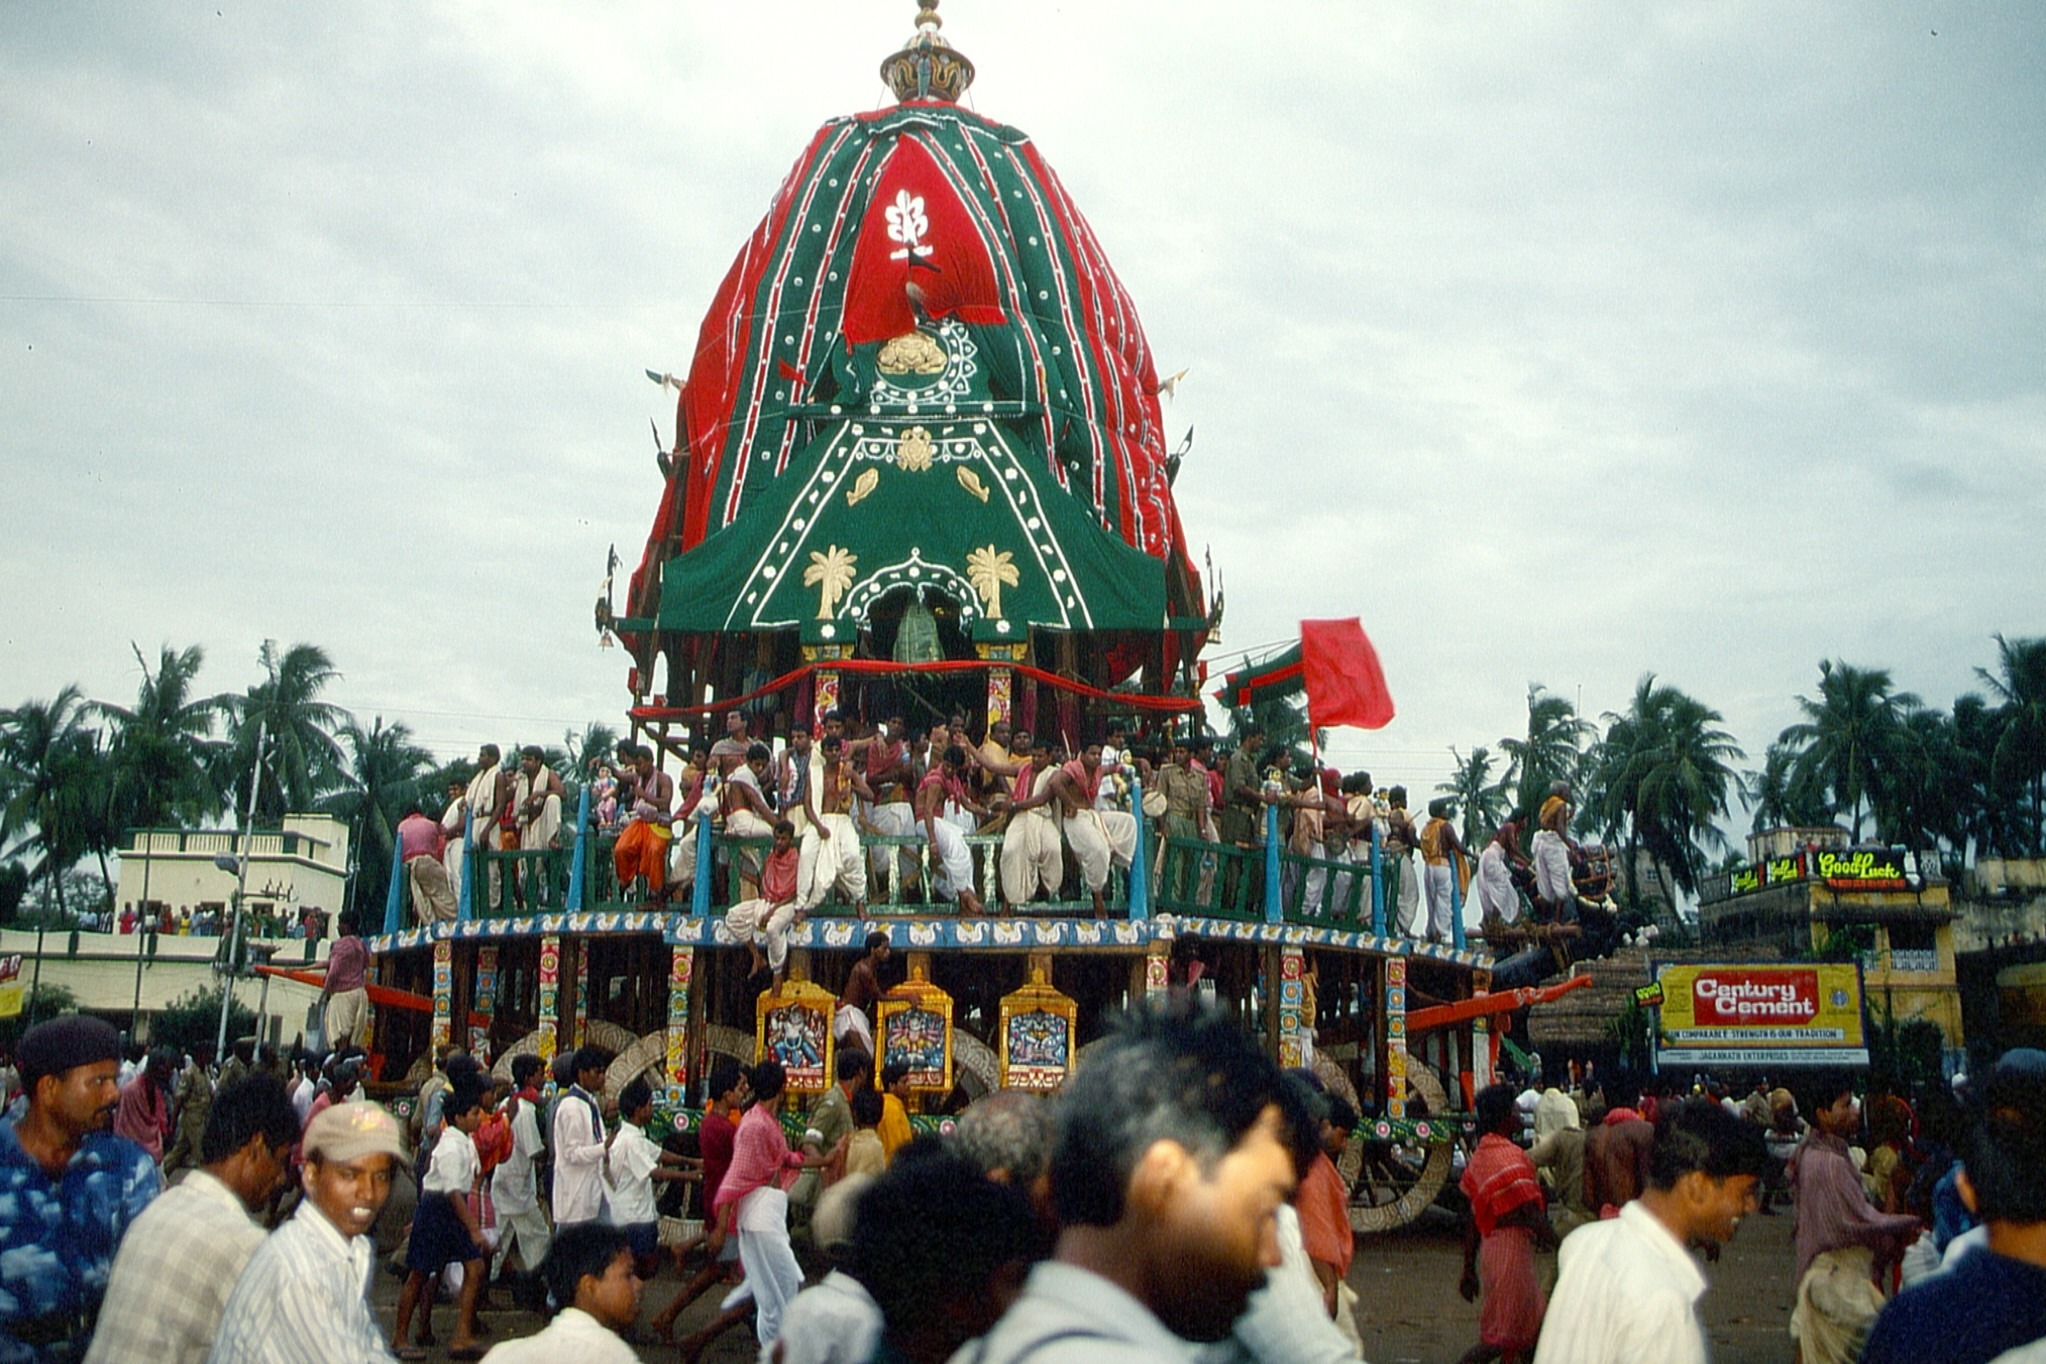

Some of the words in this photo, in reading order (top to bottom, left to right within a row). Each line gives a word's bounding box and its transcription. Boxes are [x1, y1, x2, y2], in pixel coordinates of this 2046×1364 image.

[1819, 851, 1860, 878] Good
[1858, 851, 1900, 879] Luck
[1696, 979, 1796, 1001] Century
[1715, 996, 1815, 1015] Cement
[1682, 1030, 1727, 1038] COMPARABLE
[1732, 1030, 1768, 1038] STRENGTH
[1770, 1030, 1777, 1038] IS
[1778, 1030, 1792, 1038] OUR
[1796, 1029, 1837, 1038] TRADITION
[1699, 1052, 1741, 1060] JAGANNATH
[1744, 1051, 1788, 1060] ENTERPRISES
